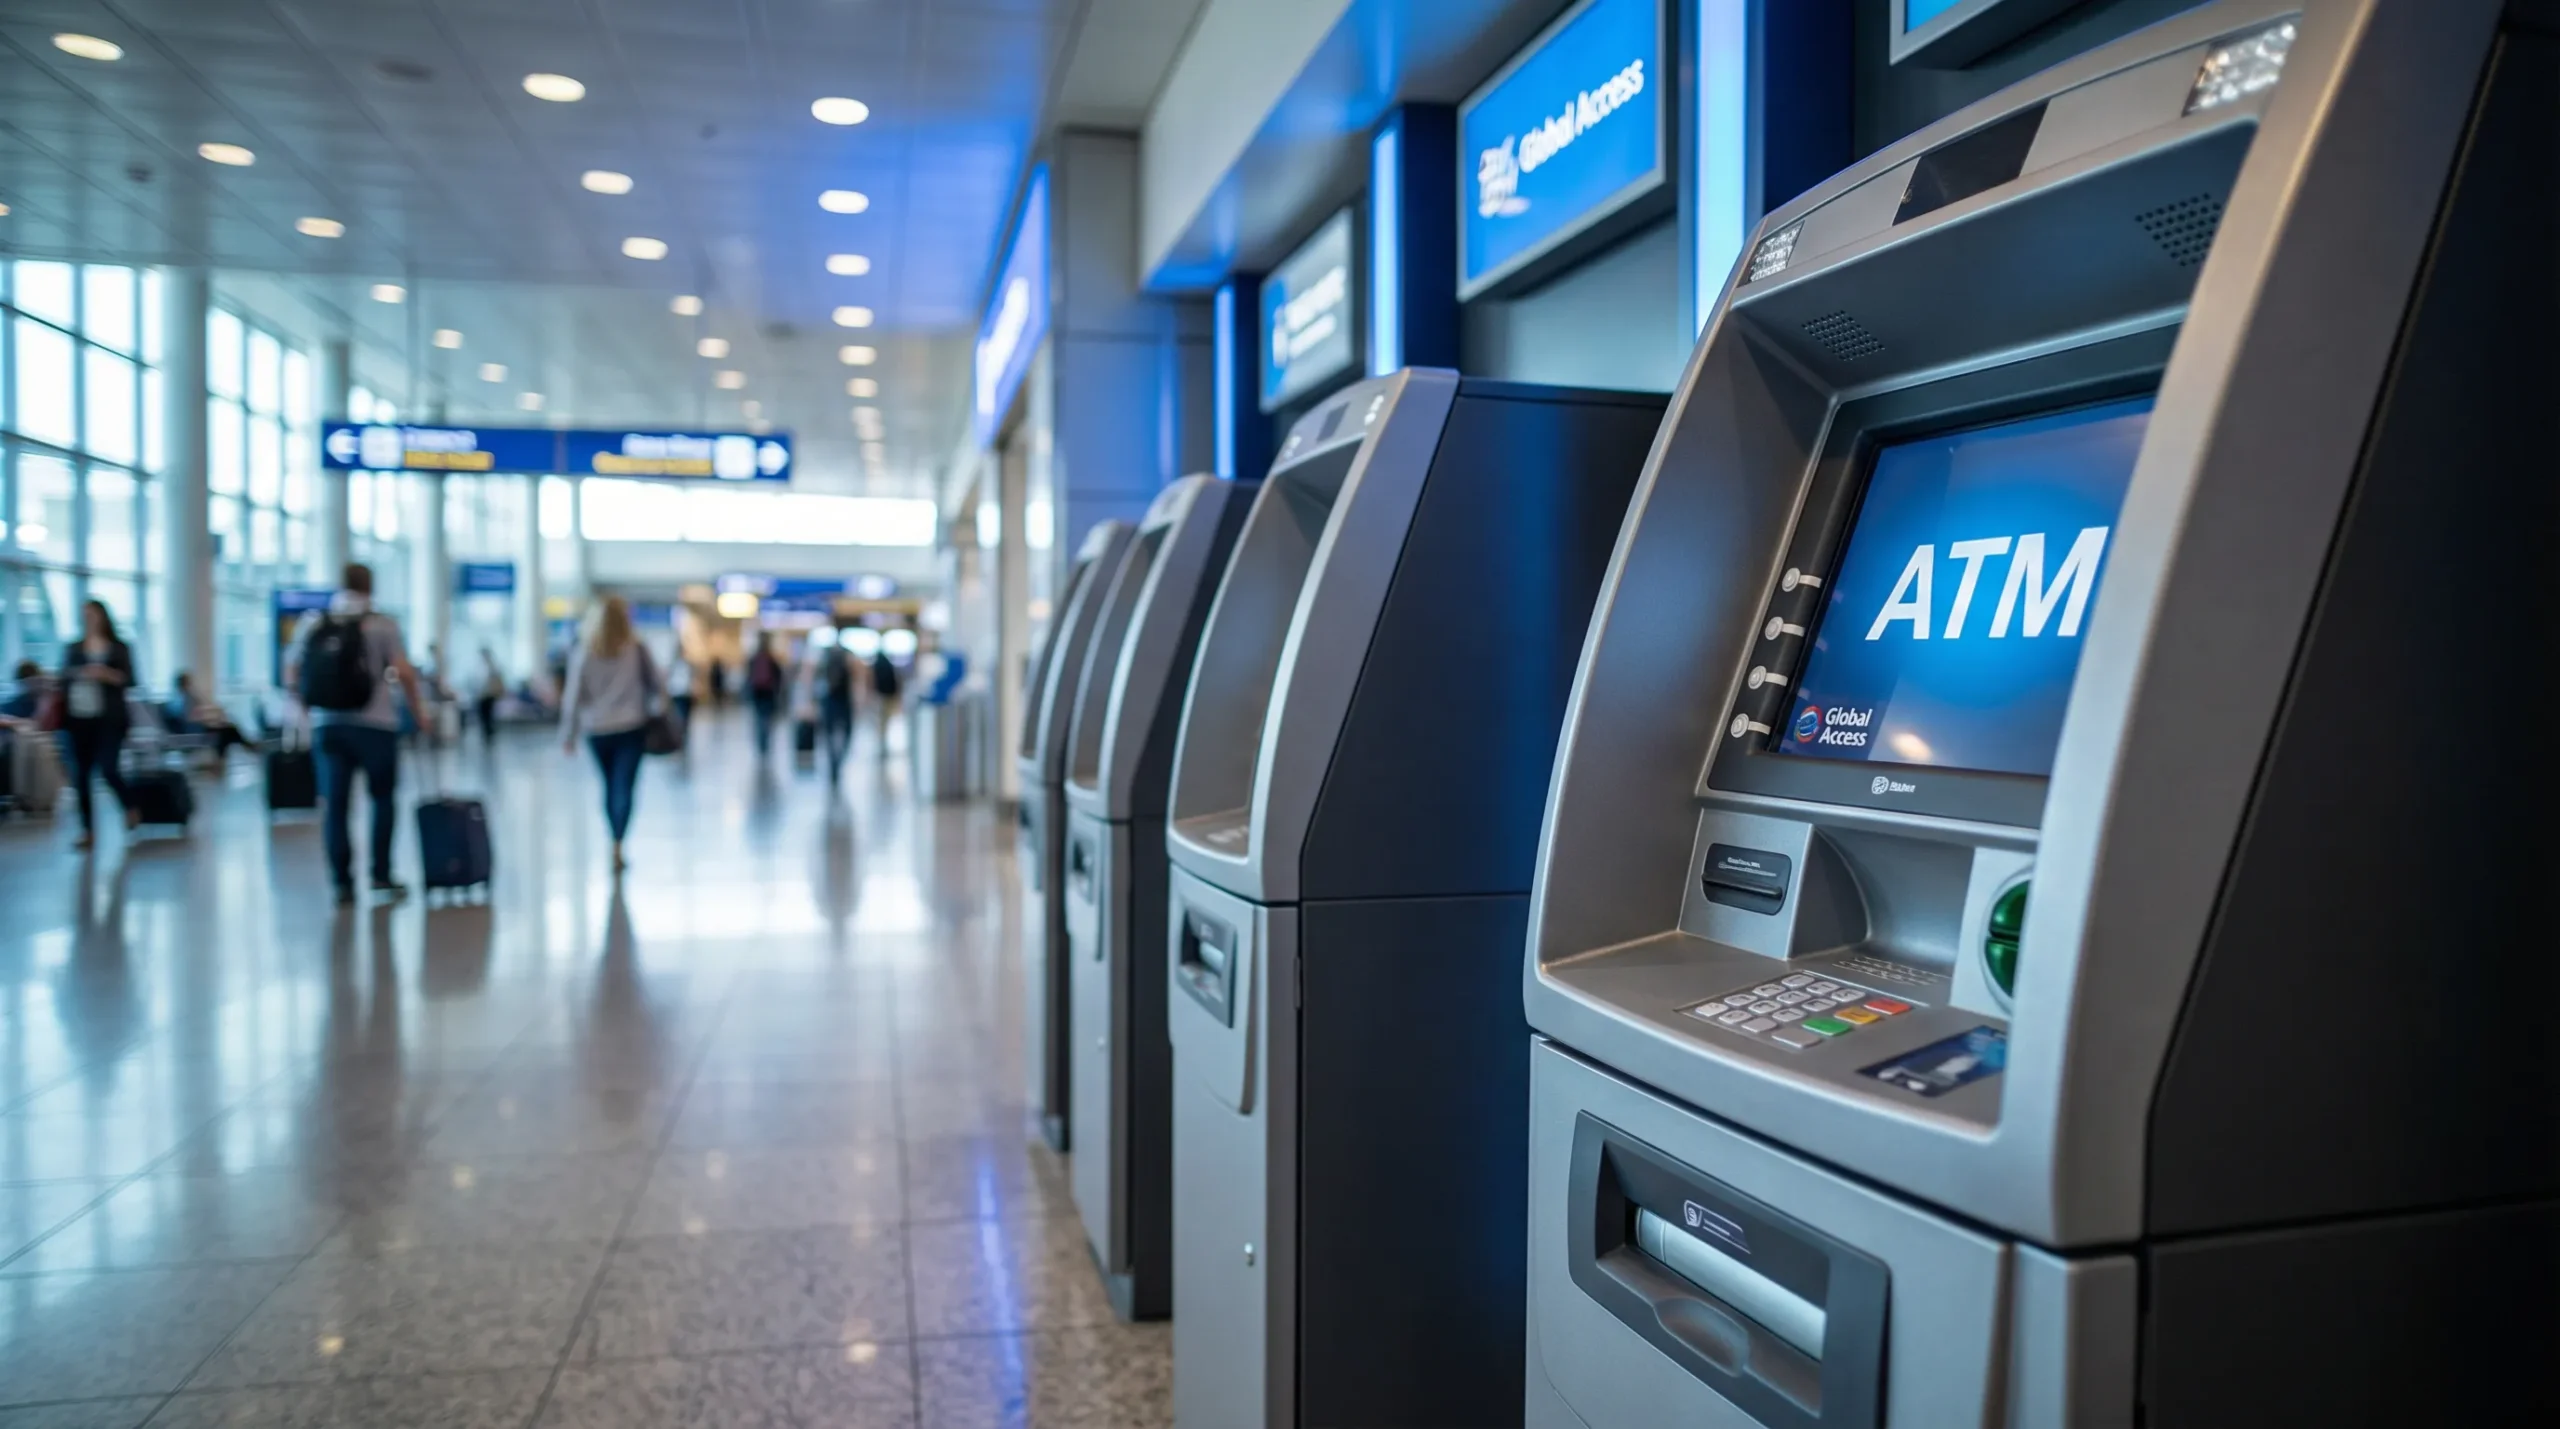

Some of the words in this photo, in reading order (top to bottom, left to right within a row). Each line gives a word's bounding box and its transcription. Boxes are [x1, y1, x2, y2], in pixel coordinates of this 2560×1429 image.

[1518, 101, 1575, 173] Global
[1575, 58, 1645, 136] Access
[1865, 526, 2109, 640] ATM
[1818, 726, 1868, 746] Access
[1825, 707, 1873, 727] Global
